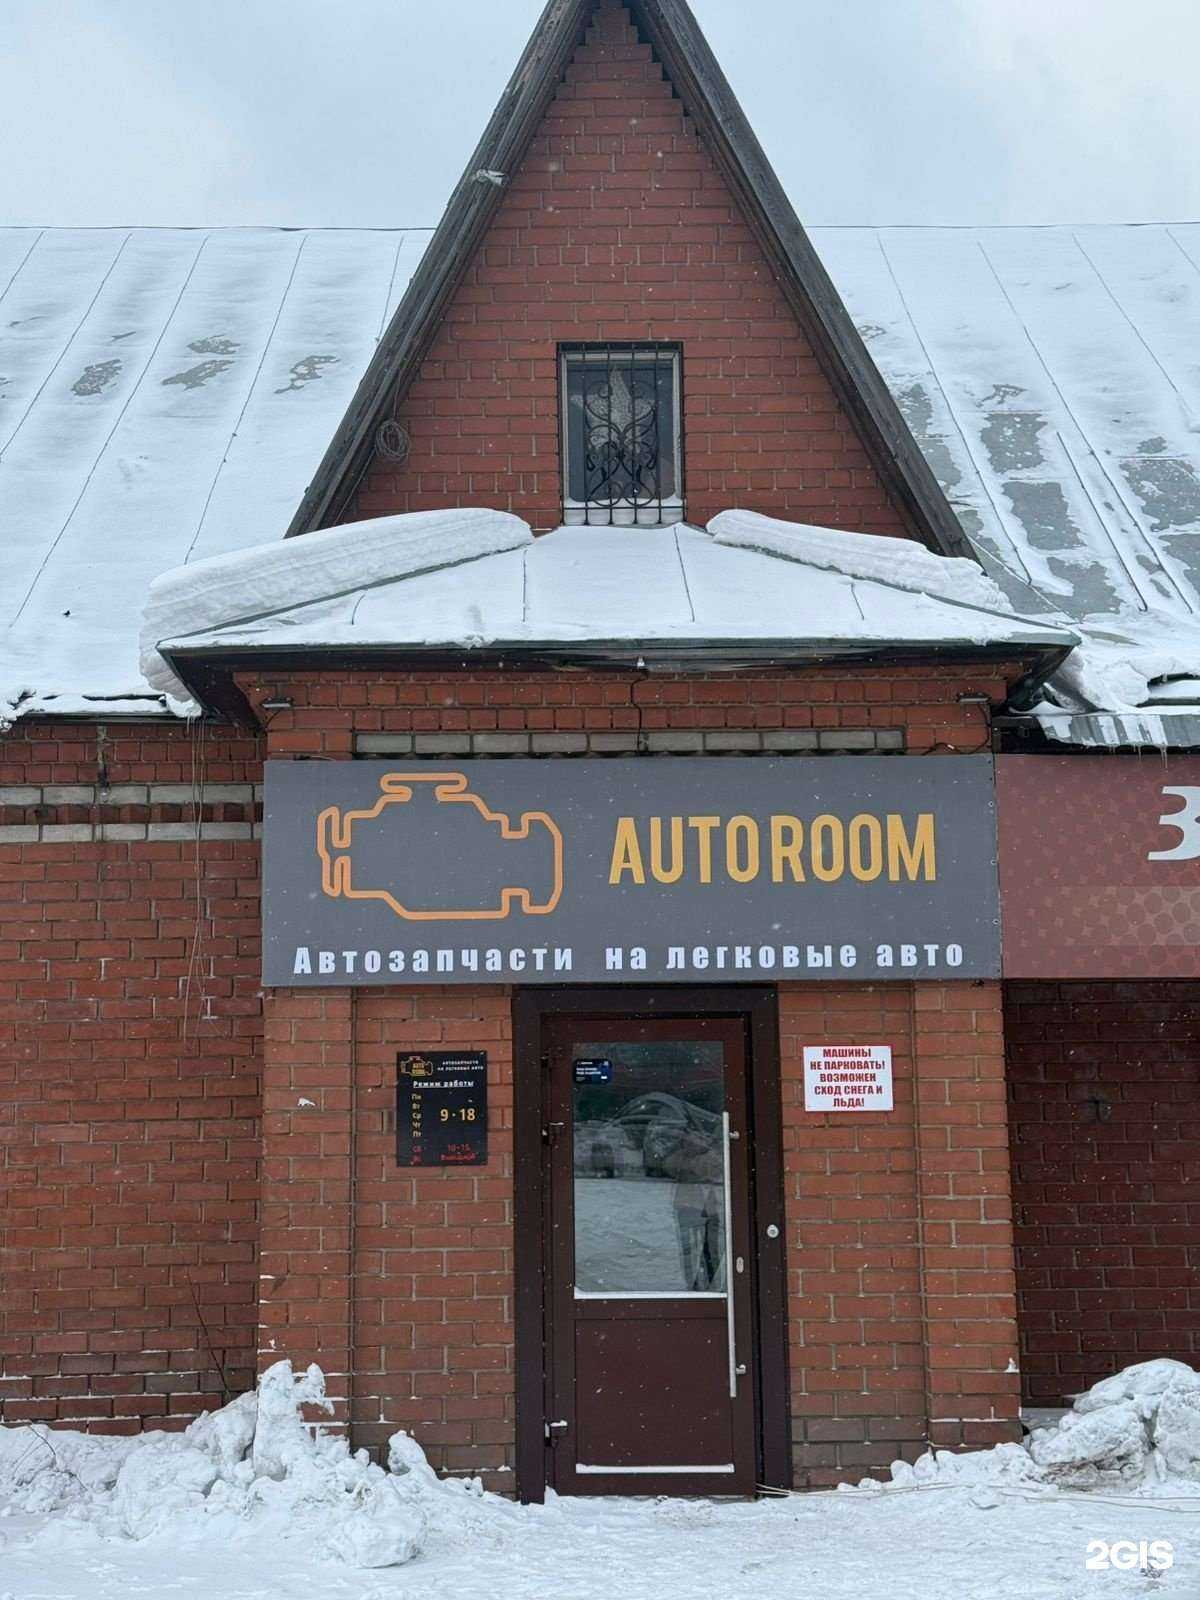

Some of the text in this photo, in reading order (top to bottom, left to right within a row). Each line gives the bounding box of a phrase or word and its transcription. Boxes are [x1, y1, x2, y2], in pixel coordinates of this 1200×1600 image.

[293, 943, 964, 975] Автозапчасти на легковые авто
[823, 1048, 871, 1058] МАШИНЫ
[810, 1060, 885, 1070] НЕ ПАРКОВАТЬ!
[820, 1073, 876, 1082] ВОЗМОЖЕН
[413, 1080, 474, 1088] Режим работы
[814, 1085, 883, 1096] СХОД СНЕГА И
[833, 1098, 864, 1108] ЛЬДА!
